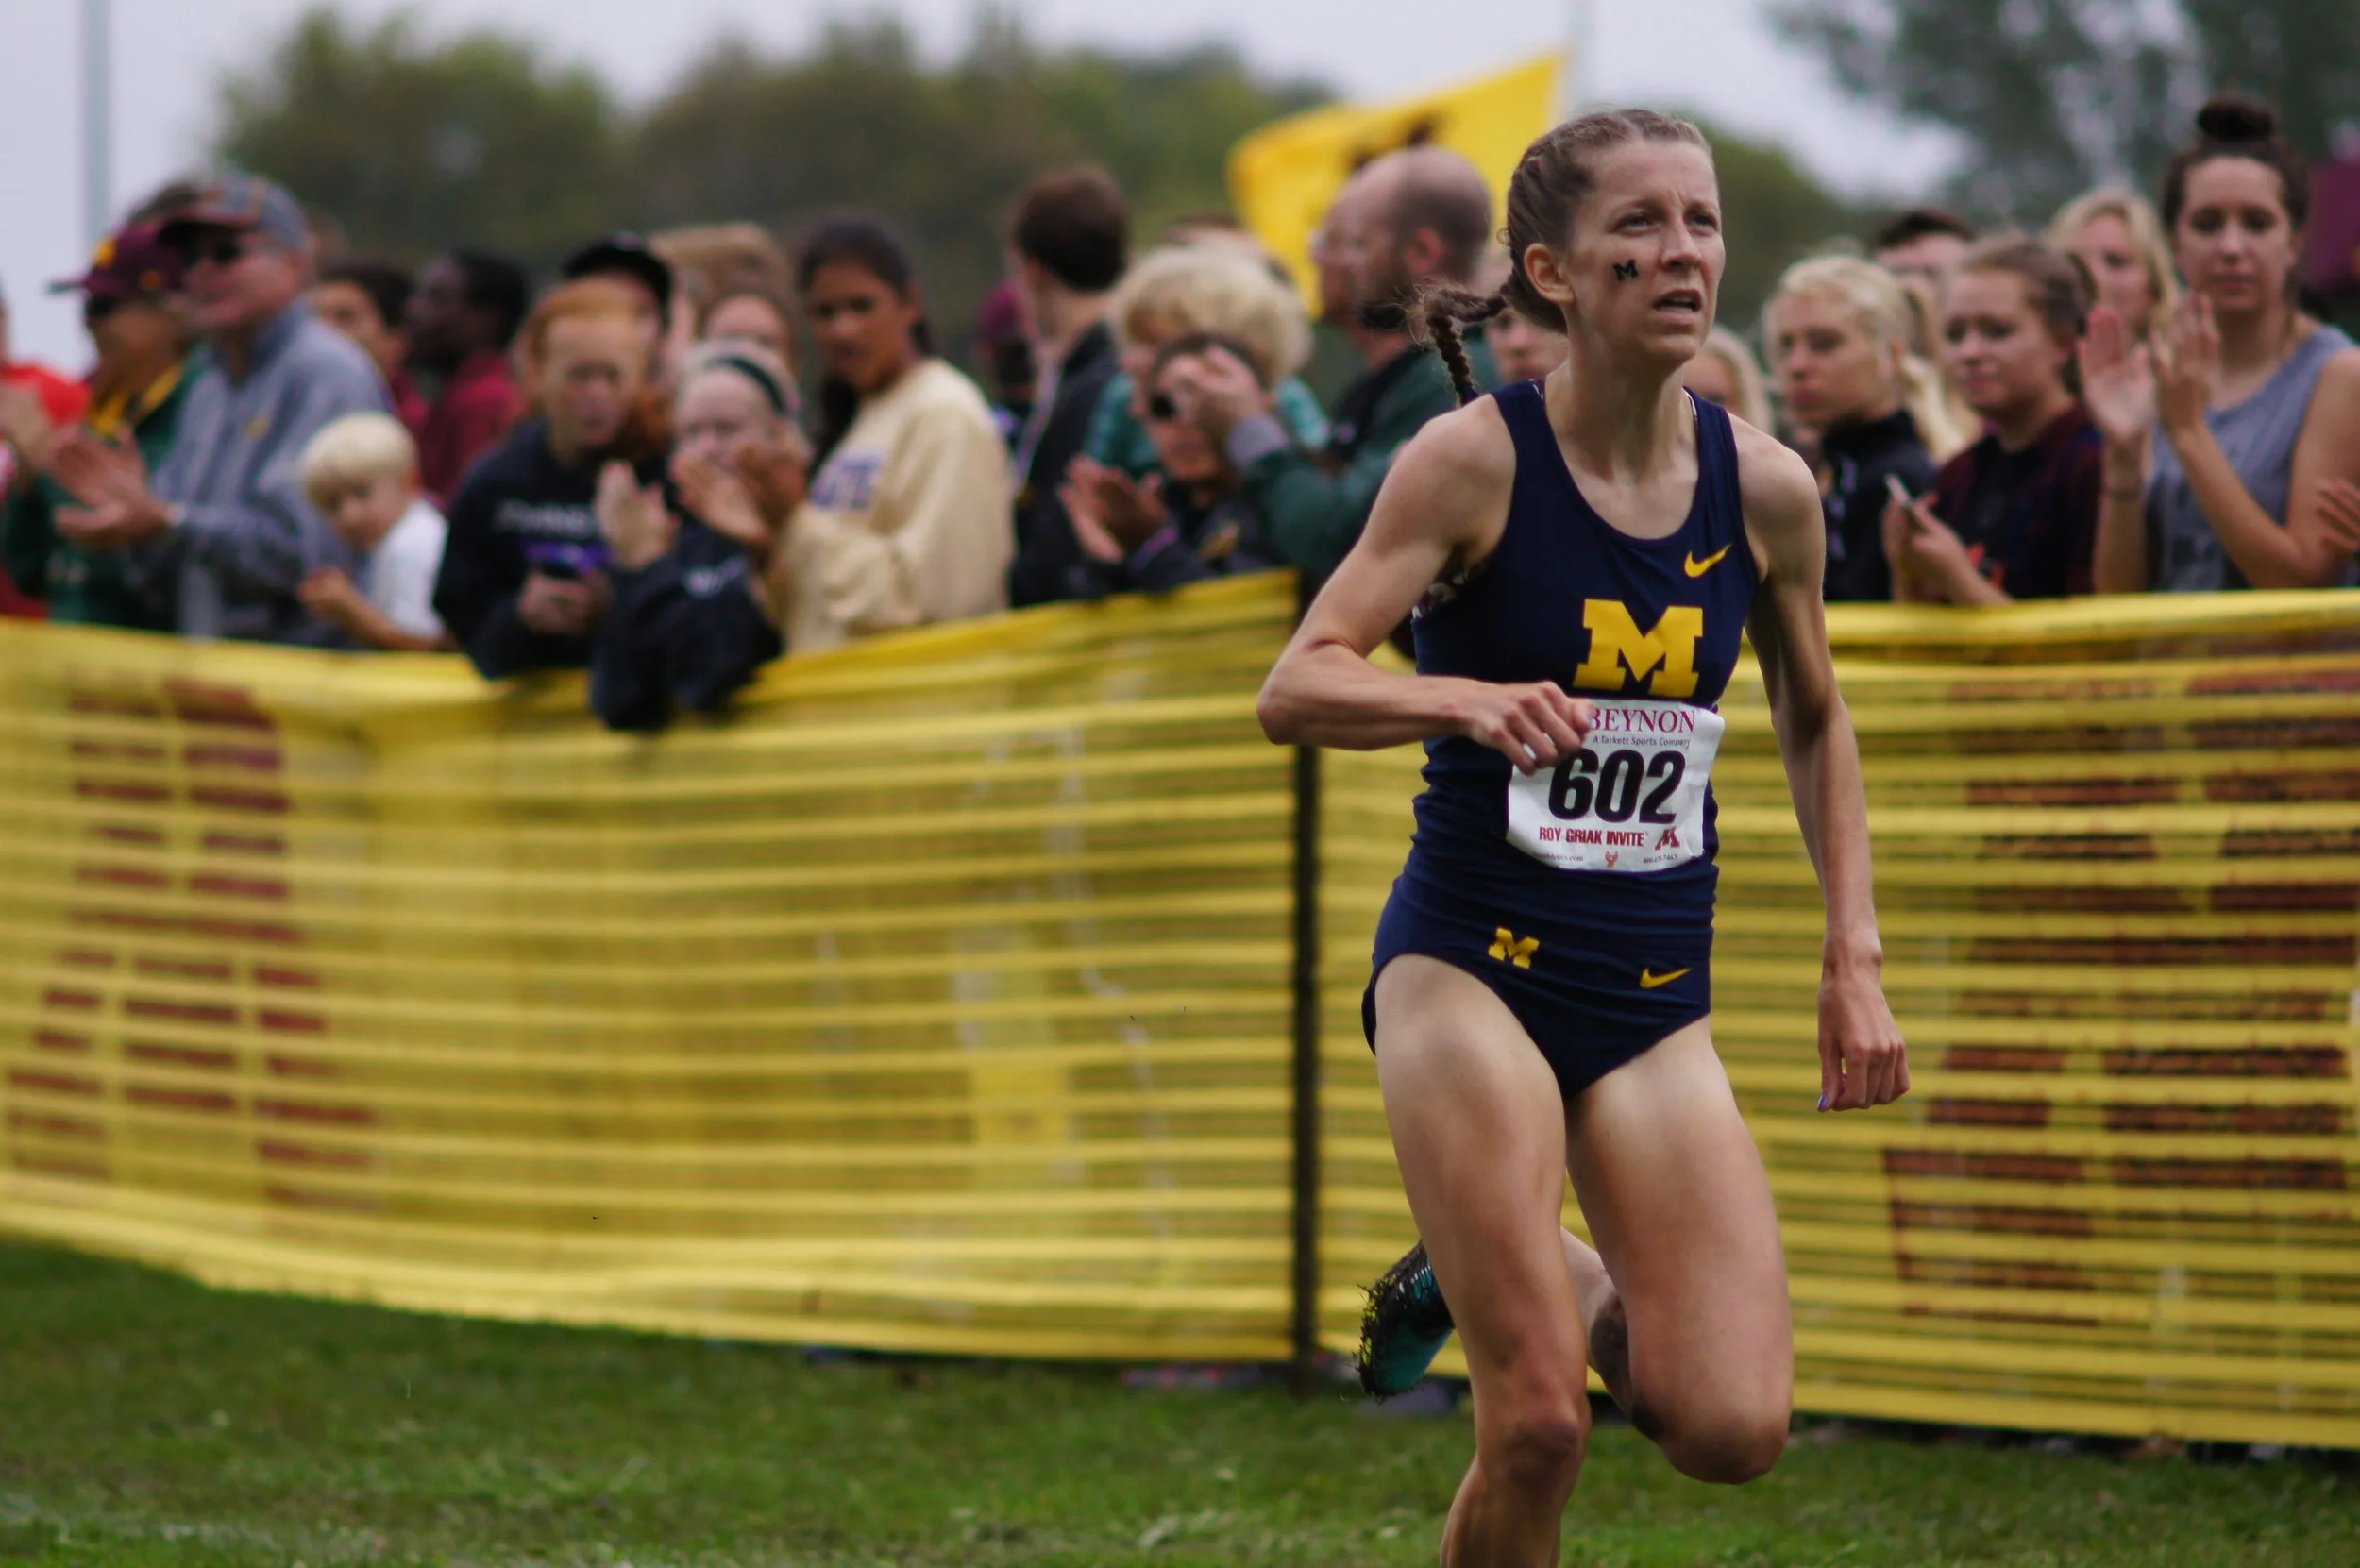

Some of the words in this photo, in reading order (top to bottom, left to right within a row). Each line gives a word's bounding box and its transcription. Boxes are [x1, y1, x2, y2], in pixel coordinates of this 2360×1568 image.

[1572, 598, 1703, 698] M
[1592, 708, 1695, 733] BEYNON
[1601, 735, 1629, 746] Tarkett
[1631, 737, 1657, 747] Sports
[1659, 738, 1691, 749] Company
[1548, 748, 1686, 824] 602
[1539, 826, 1561, 842] ROY
[1565, 828, 1603, 845] GRIAK
[1606, 831, 1644, 847] INVITE
[1488, 926, 1540, 969] M
